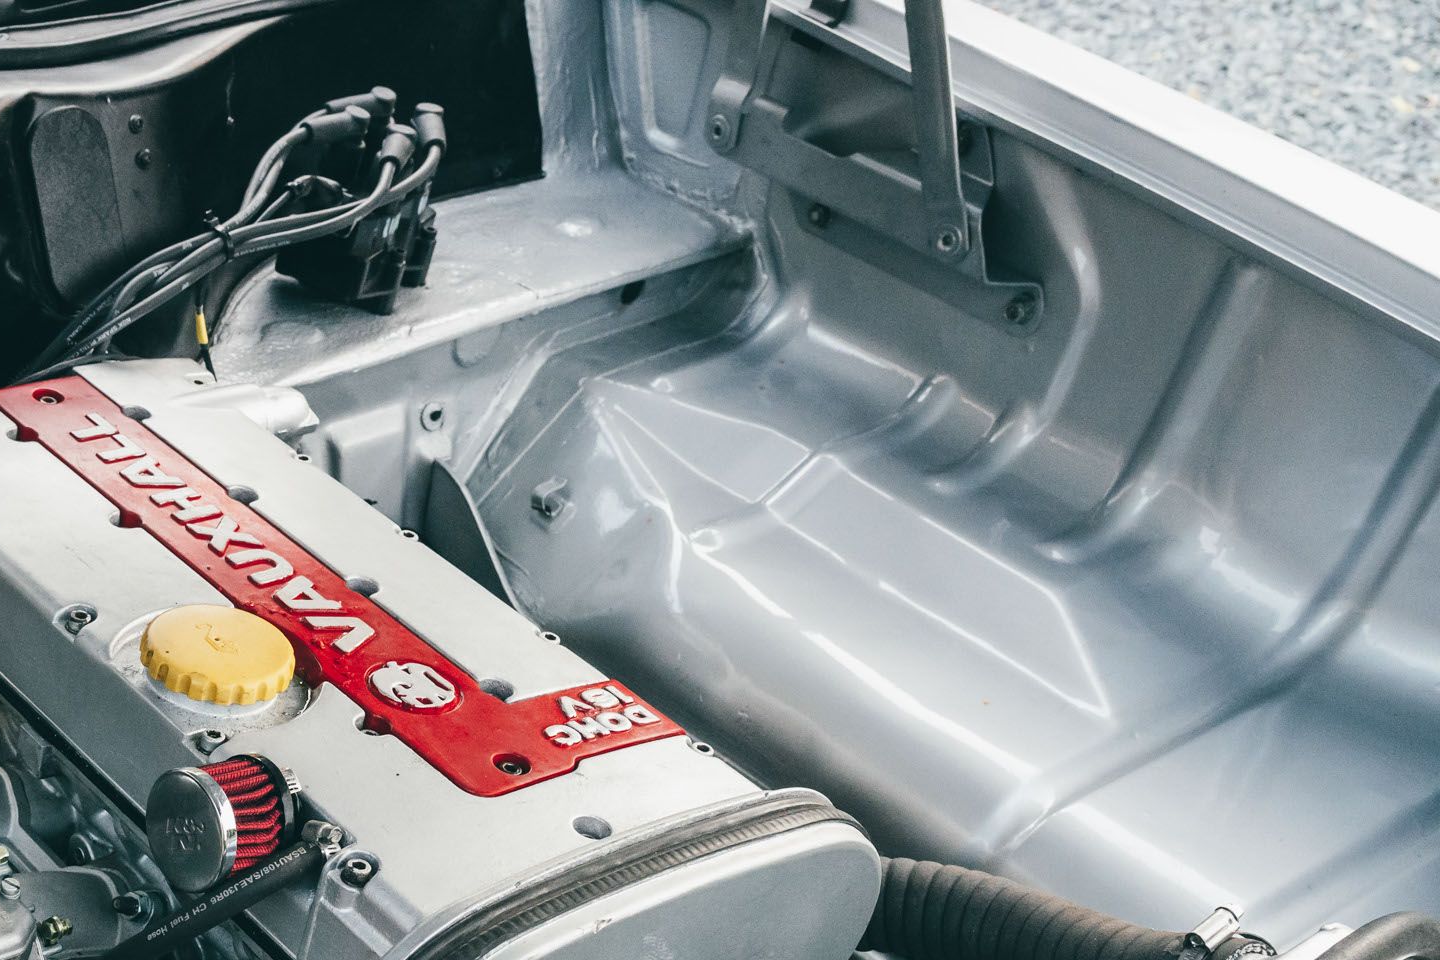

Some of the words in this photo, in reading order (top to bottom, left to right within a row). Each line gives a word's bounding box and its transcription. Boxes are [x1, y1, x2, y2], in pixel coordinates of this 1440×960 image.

[70, 412, 376, 655] VAUXHALL
[558, 685, 634, 719] 16V
[544, 704, 661, 746] DOHC
[210, 846, 307, 905] BSAU108/SAEJ30R6
[170, 914, 190, 929] Fuel
[193, 904, 208, 917] CH
[147, 926, 169, 941] Hose
